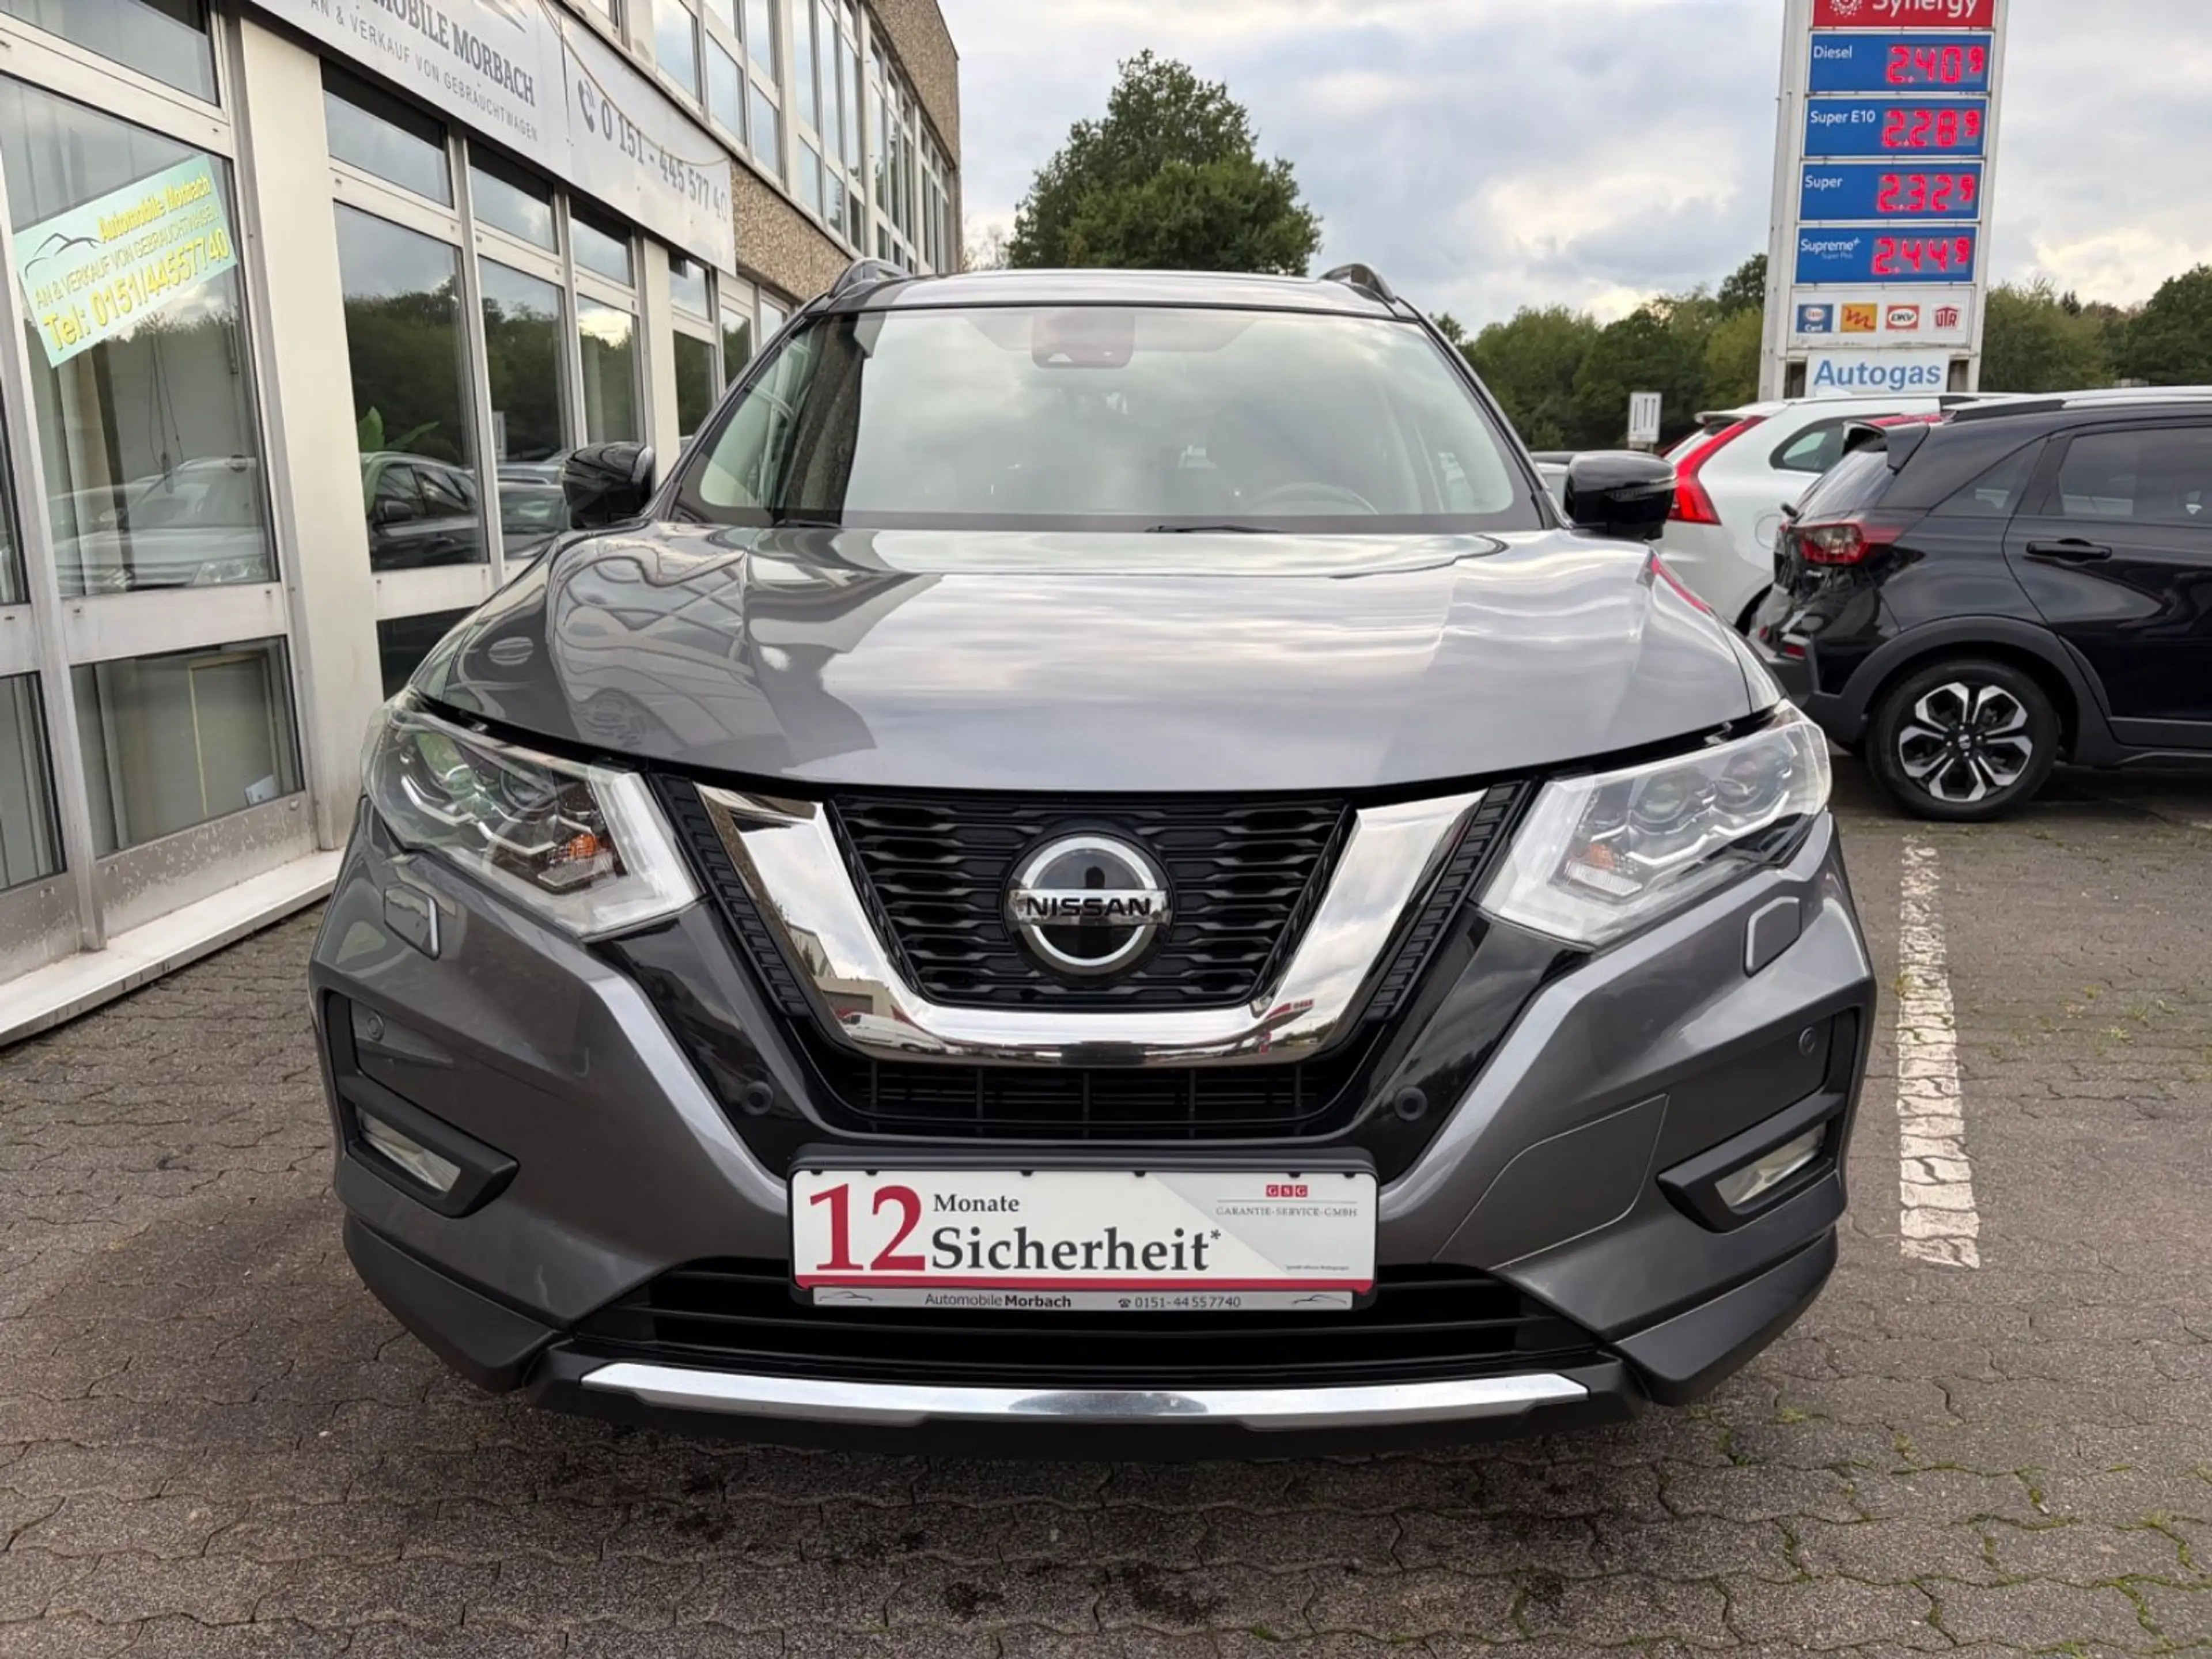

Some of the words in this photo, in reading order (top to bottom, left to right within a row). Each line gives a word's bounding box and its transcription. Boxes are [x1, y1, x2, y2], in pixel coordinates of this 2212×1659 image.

[1872, 0, 1978, 18] Synergy
[1813, 46, 1853, 59] Diesel
[452, 22, 536, 107] MORBACH
[350, 13, 410, 63] VERKAUF
[415, 53, 440, 83] VON
[444, 72, 538, 142] GEBRAUCHTWAGEN
[1810, 111, 1848, 126] Super
[1851, 111, 1876, 123] E10
[1805, 175, 1843, 191] Super
[44, 302, 90, 352] Tel:
[1813, 360, 1941, 391] Autogas
[1026, 897, 1150, 916] NISSAN
[1266, 1185, 1308, 1198] GSG
[810, 1183, 926, 1272] 12
[933, 1194, 1020, 1213] Monate
[925, 1293, 1003, 1306] Automobile
[1005, 1294, 1071, 1308] Morbach
